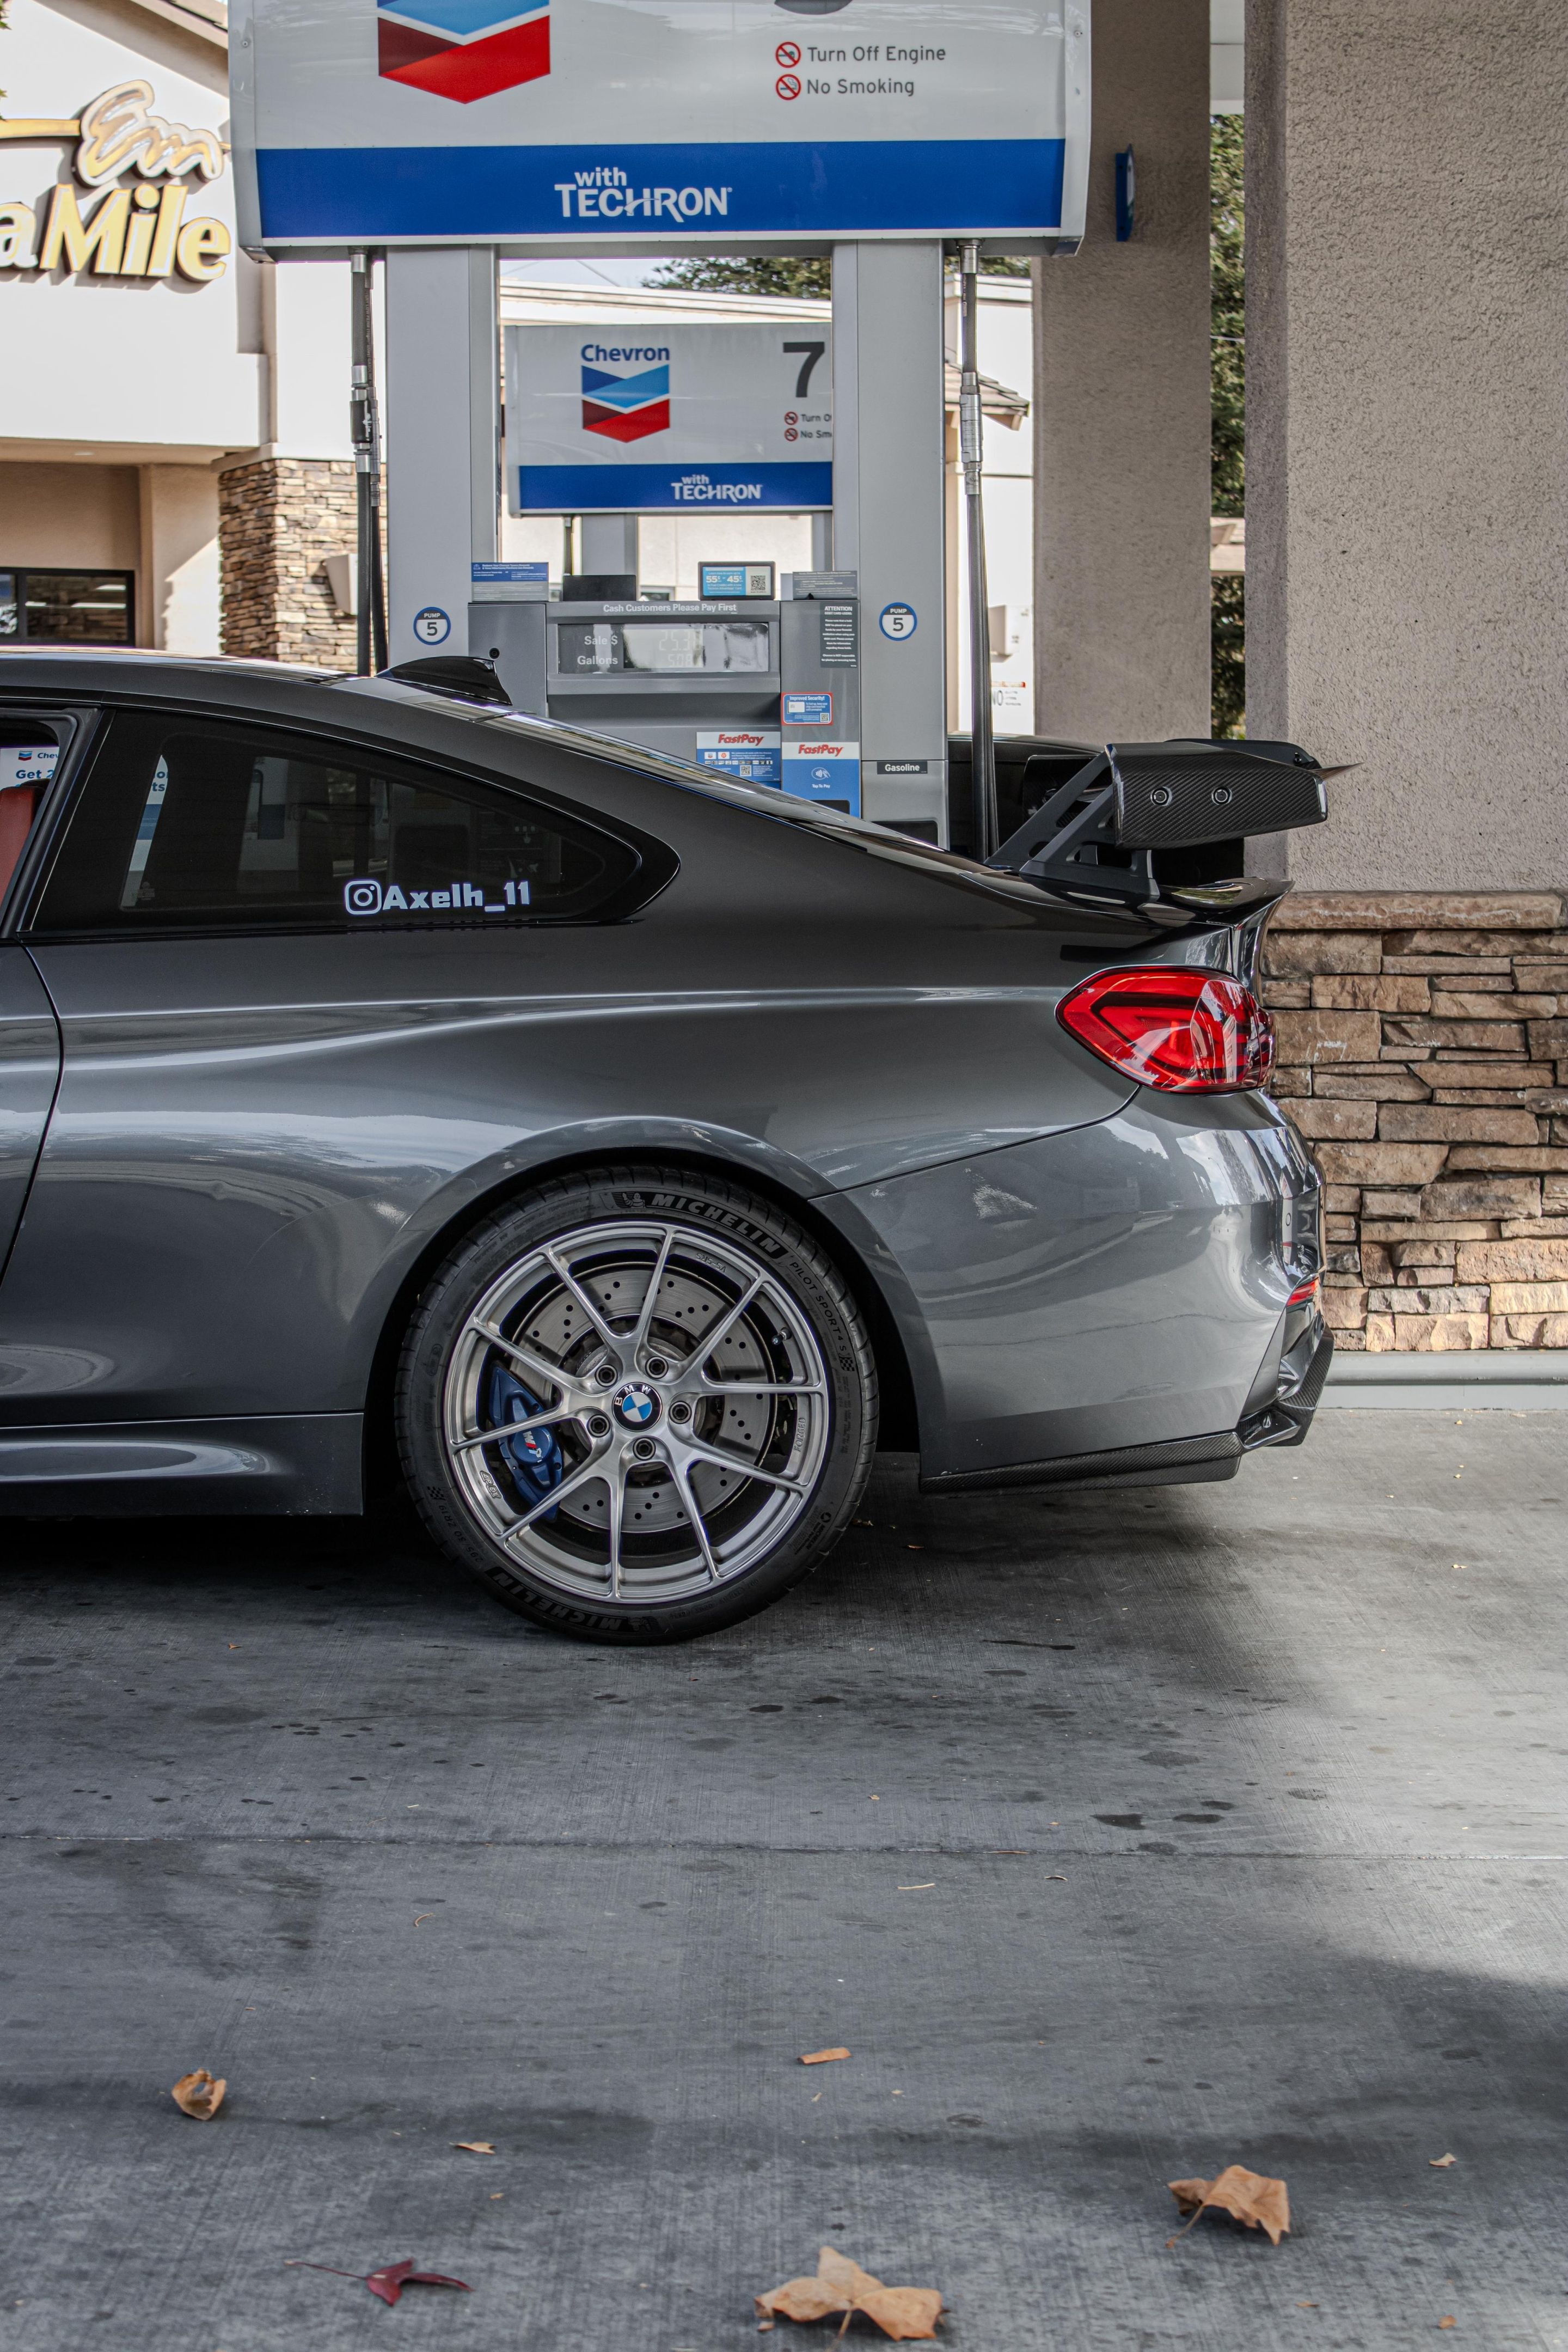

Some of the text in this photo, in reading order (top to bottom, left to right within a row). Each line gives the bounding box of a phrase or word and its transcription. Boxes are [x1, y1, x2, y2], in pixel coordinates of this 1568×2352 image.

[807, 45, 946, 65] Turn Off Engine
[807, 79, 915, 96] No Smoking
[574, 167, 627, 187] with
[554, 184, 728, 223] TECHRON
[581, 344, 670, 362] Chevron
[782, 341, 825, 398] 7
[681, 474, 709, 484] with
[671, 482, 761, 503] TECHRON
[701, 604, 715, 612] Pay
[426, 622, 438, 636] 5
[893, 618, 904, 632] 5
[584, 634, 618, 646] Sale $
[577, 656, 618, 665] Gallons
[718, 734, 764, 746] FastPay
[798, 744, 844, 756] FastPay
[16, 769, 42, 779] Get
[885, 763, 920, 772] Gasoline
[383, 881, 530, 912] Axelh_11
[651, 1193, 782, 1253] MICHELIN
[696, 1253, 726, 1273] VS-5RS
[789, 1261, 818, 1291] PILOT
[816, 1295, 841, 1334] SPORT
[614, 1384, 652, 1406] BMW
[793, 1418, 806, 1452] FORGED
[480, 1470, 501, 1498] APEX
[439, 1505, 457, 1527] ZR19
[805, 1523, 826, 1550] MICHELIN
[492, 1572, 623, 1630] MICHELIN
